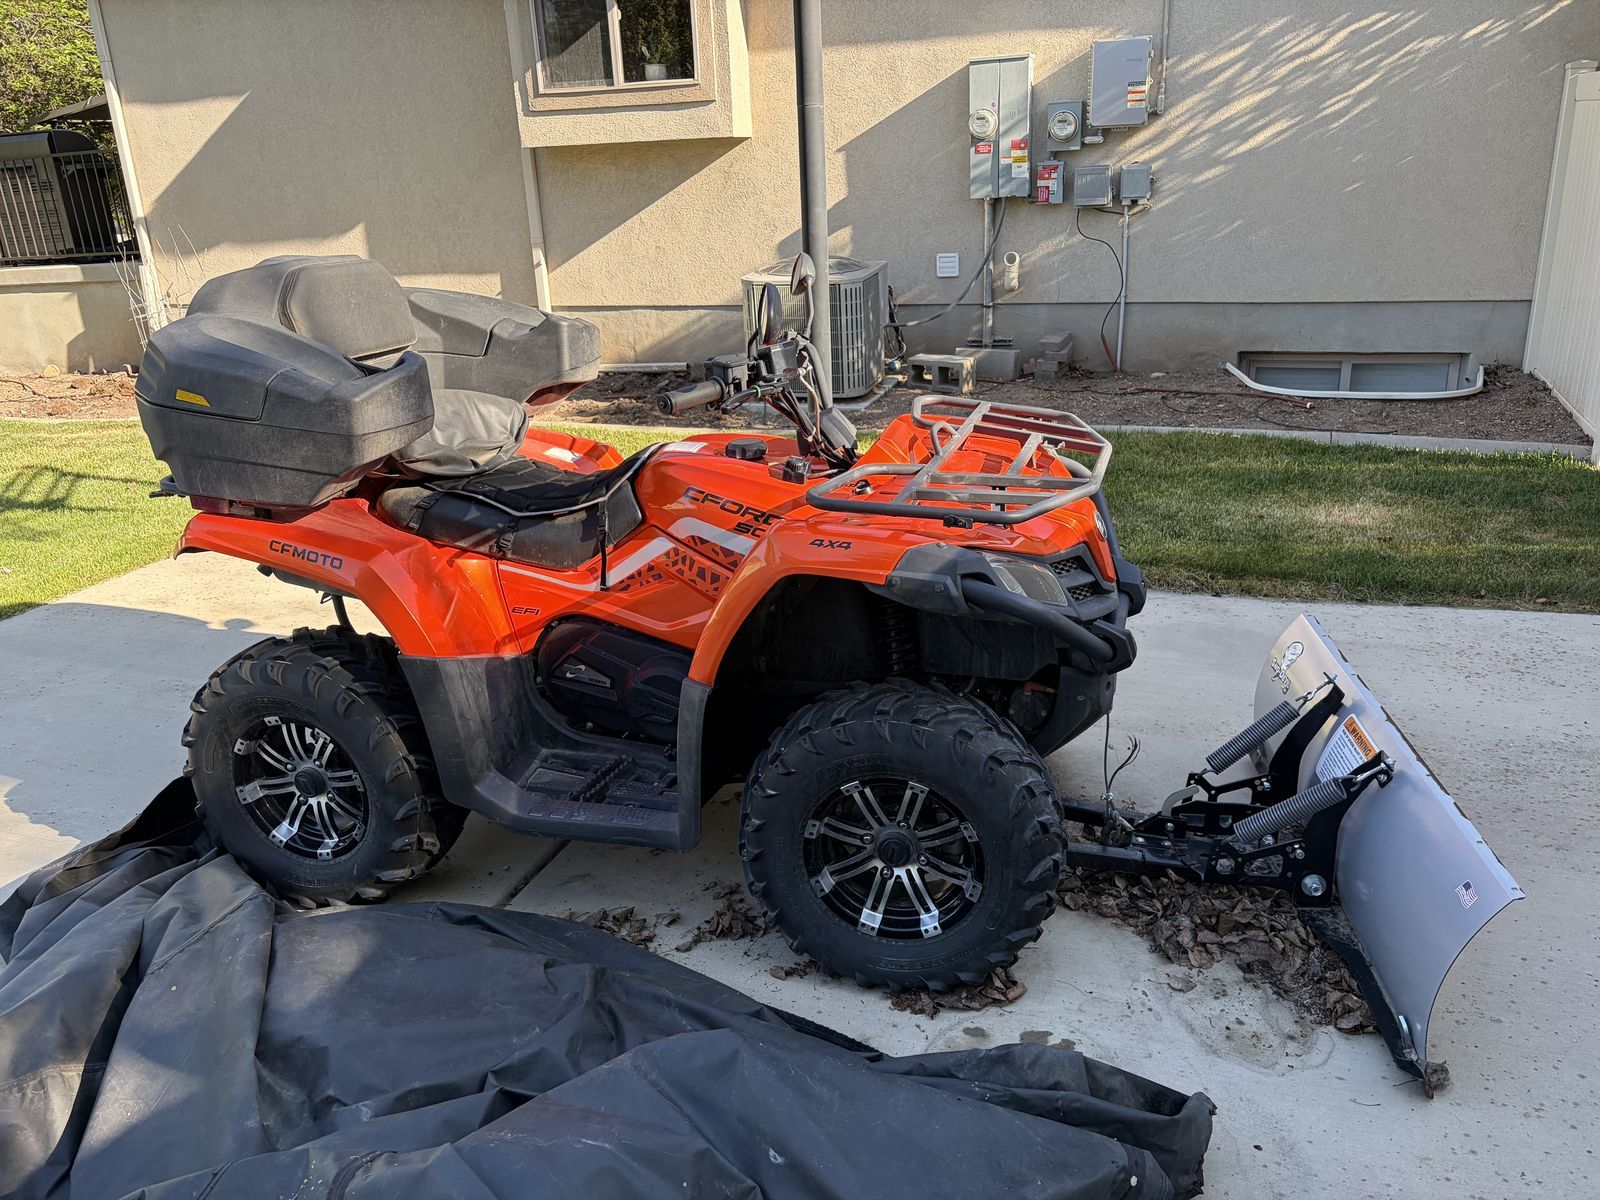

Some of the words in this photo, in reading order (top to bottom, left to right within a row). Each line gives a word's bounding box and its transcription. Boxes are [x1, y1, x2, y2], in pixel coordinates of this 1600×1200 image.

[269, 539, 343, 570] CFMOTO
[511, 606, 540, 616] EFI
[1350, 726, 1373, 757] WARNING
